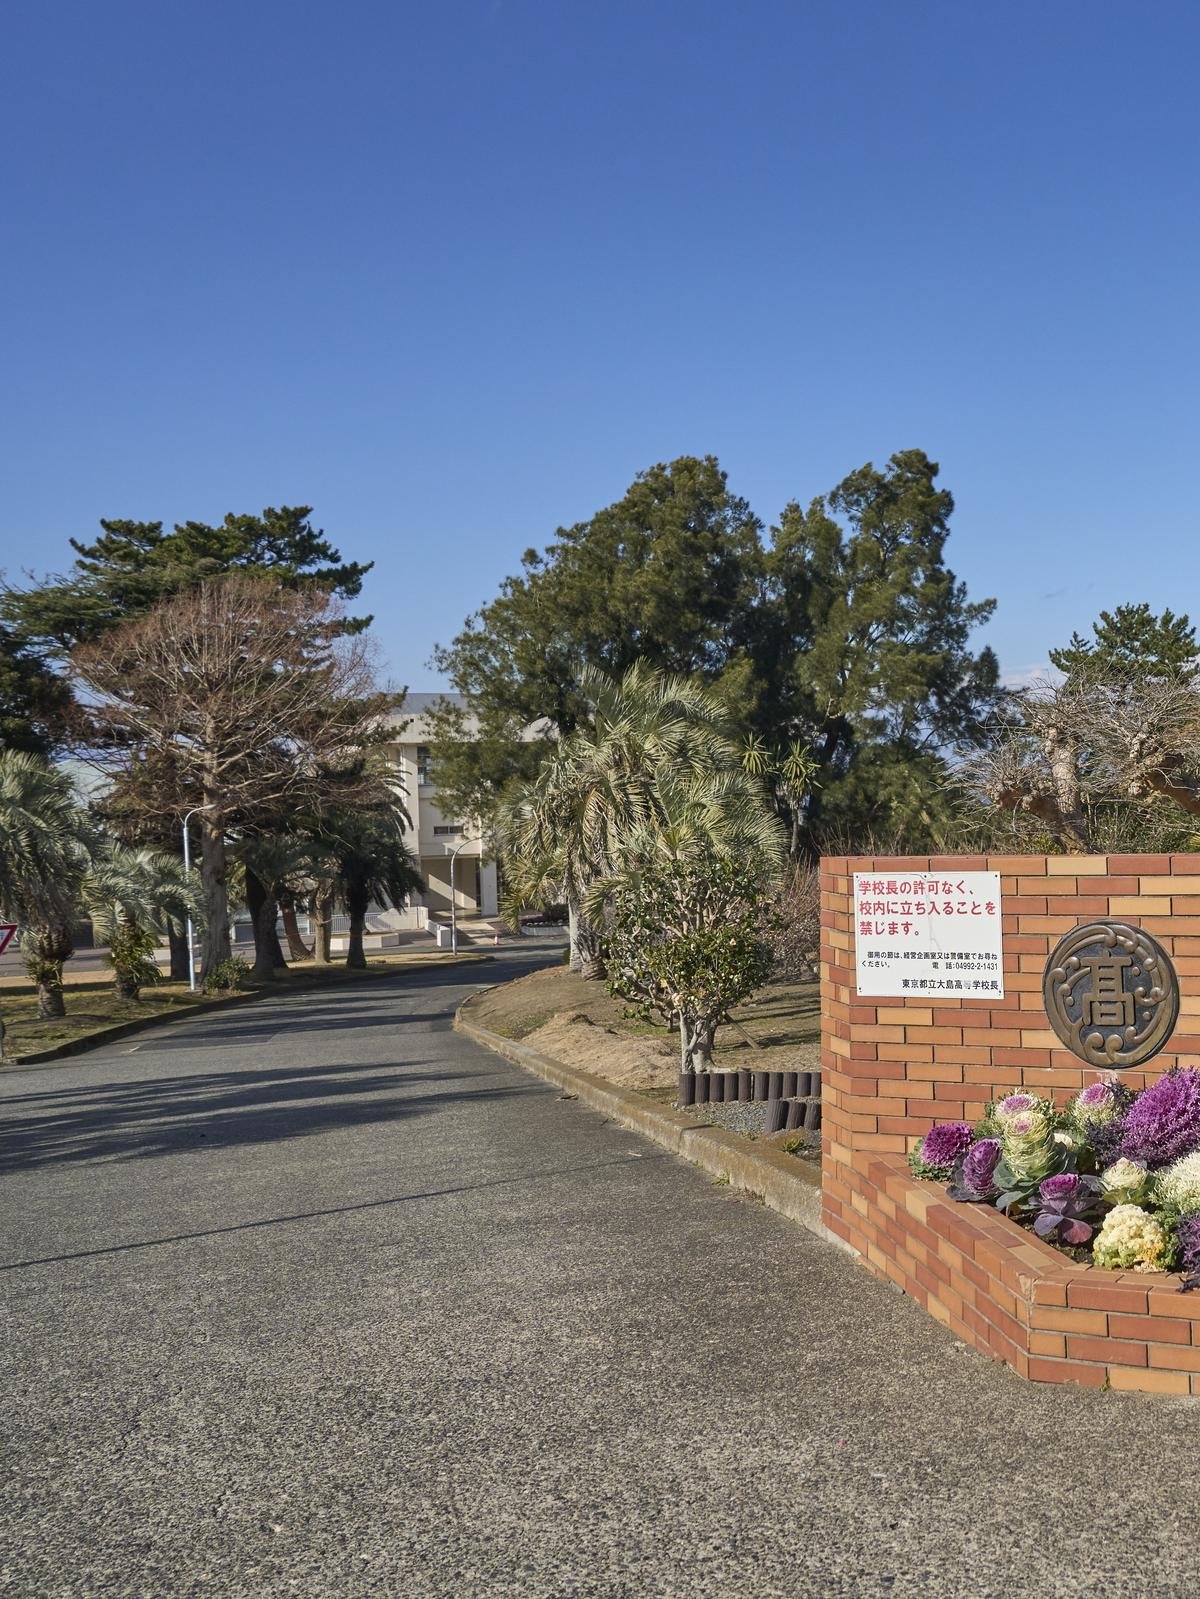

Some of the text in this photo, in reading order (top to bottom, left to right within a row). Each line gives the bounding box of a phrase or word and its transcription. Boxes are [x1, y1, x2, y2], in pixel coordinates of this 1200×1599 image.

[858, 880, 974, 896] 学校長の許可なく、
[859, 901, 996, 916] 校内に立ち入ることを
[860, 921, 920, 936] 禁じます。
[861, 960, 891, 968] ください。
